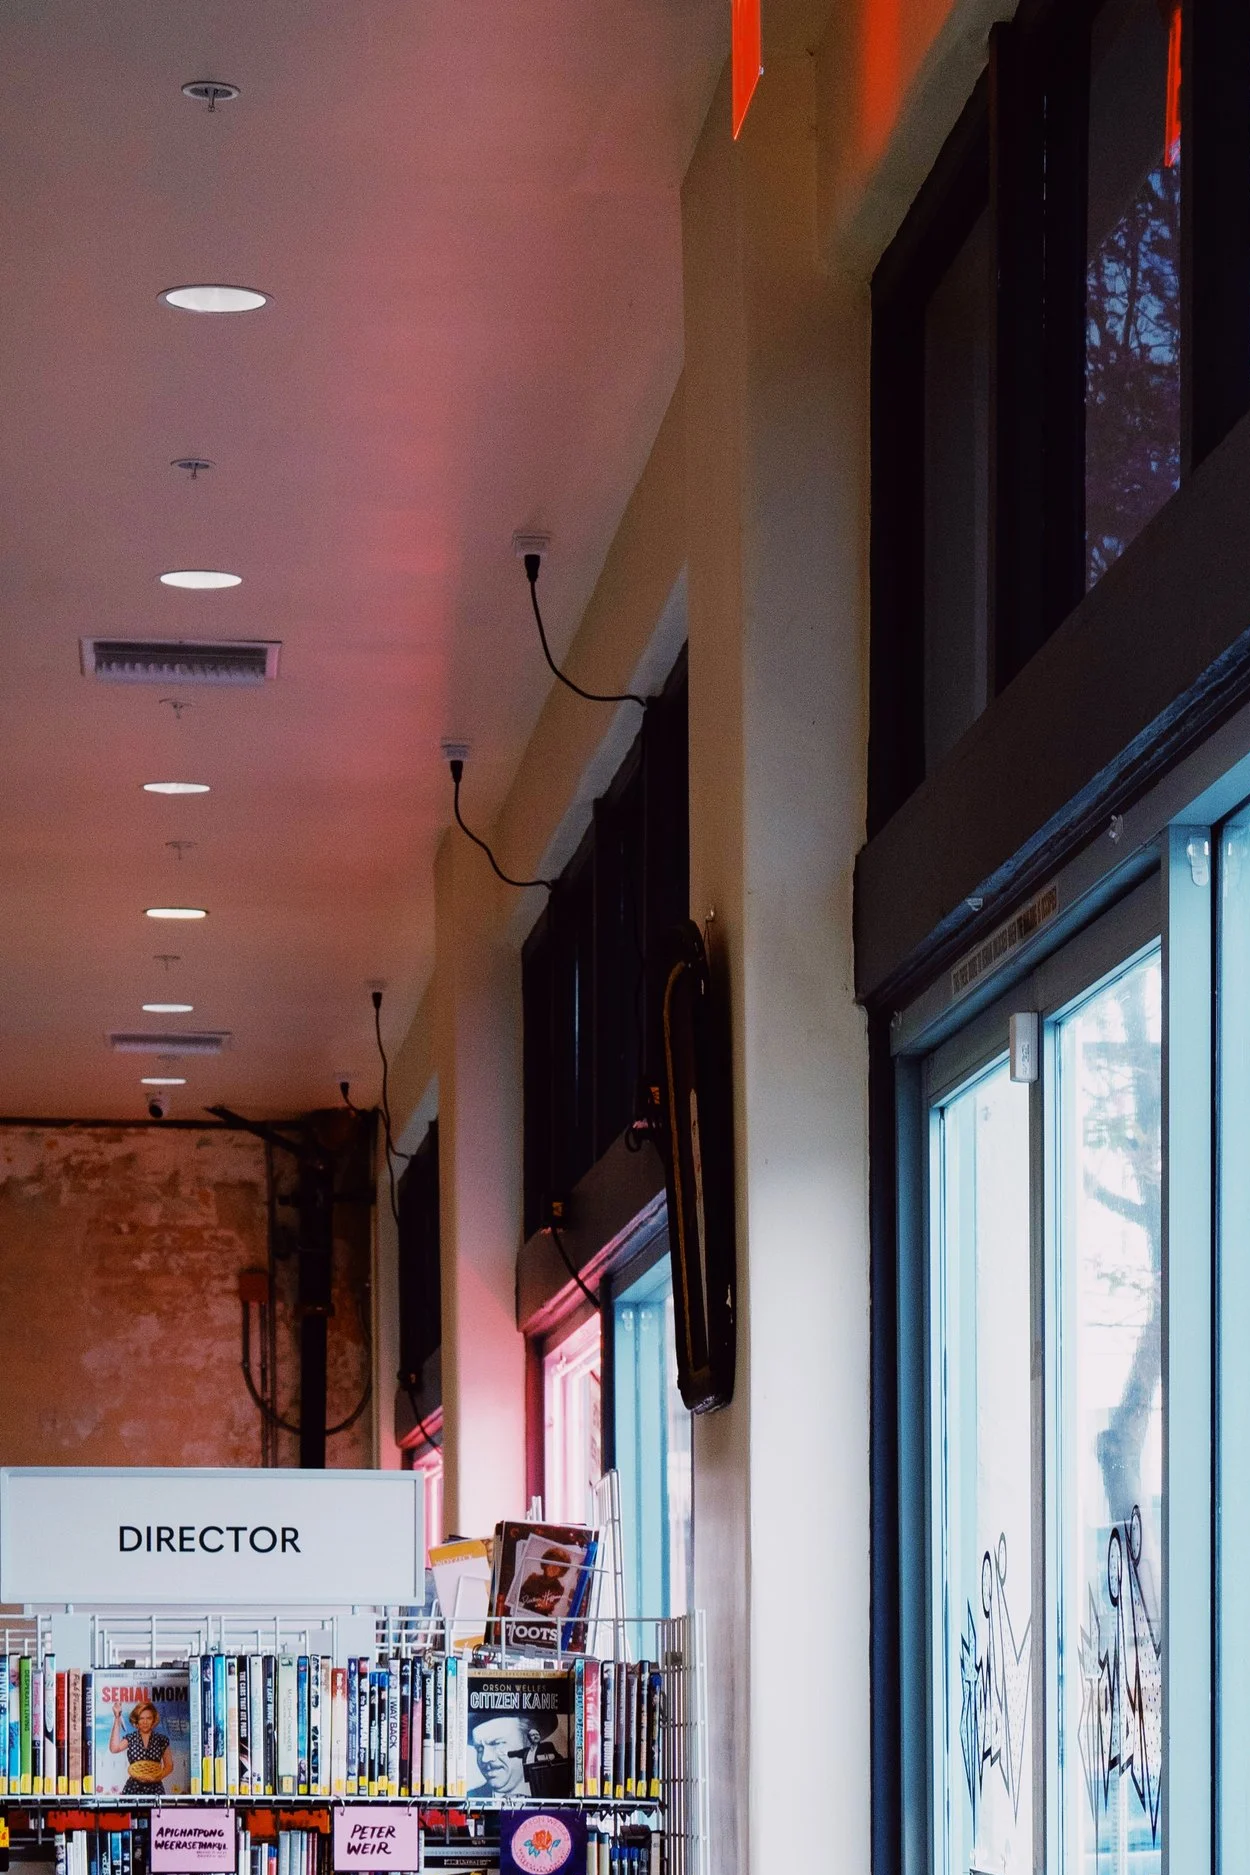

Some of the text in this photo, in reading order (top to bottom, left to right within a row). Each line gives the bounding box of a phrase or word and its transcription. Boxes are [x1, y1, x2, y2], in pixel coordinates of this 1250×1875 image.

[118, 1525, 302, 1554] DIRECTOR
[102, 1686, 188, 1703] SERIAL MOM
[482, 1683, 546, 1692] ORSON WELLES
[470, 1692, 559, 1710] CITIZEN KANE
[390, 1702, 398, 1748] WAY BACK
[604, 1741, 613, 1776] QUIXOTE
[156, 1827, 225, 1838] APICHATPONG
[350, 1824, 396, 1839] PETER
[154, 1840, 228, 1851] WEERASETHAKUL
[346, 1841, 392, 1856] WEIR
